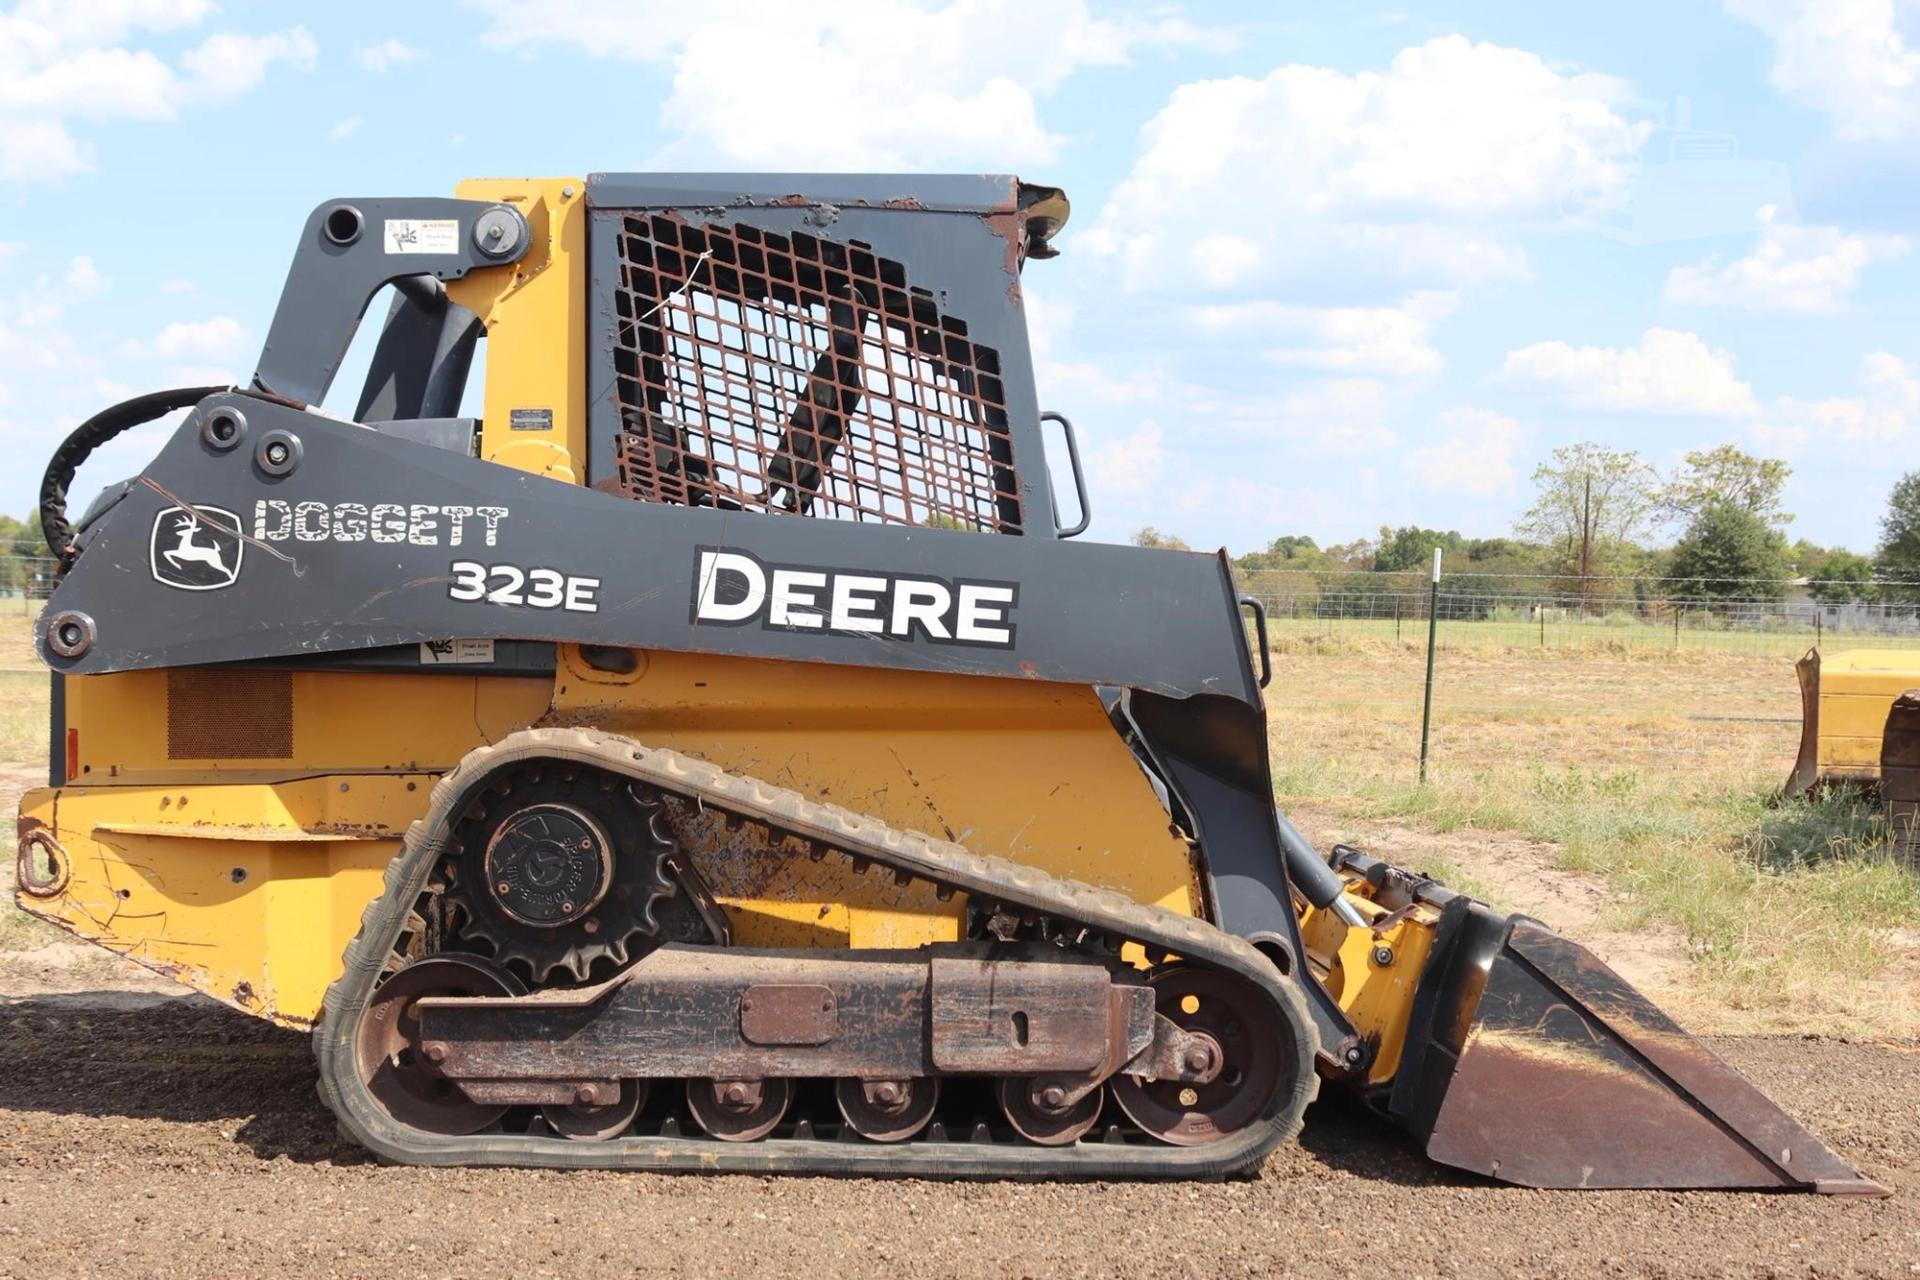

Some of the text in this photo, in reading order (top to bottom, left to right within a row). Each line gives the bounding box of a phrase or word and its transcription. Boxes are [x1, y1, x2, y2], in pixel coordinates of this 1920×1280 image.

[254, 499, 509, 546] DOGGETT
[449, 561, 600, 613] 323E
[697, 551, 1013, 643] DEERE
